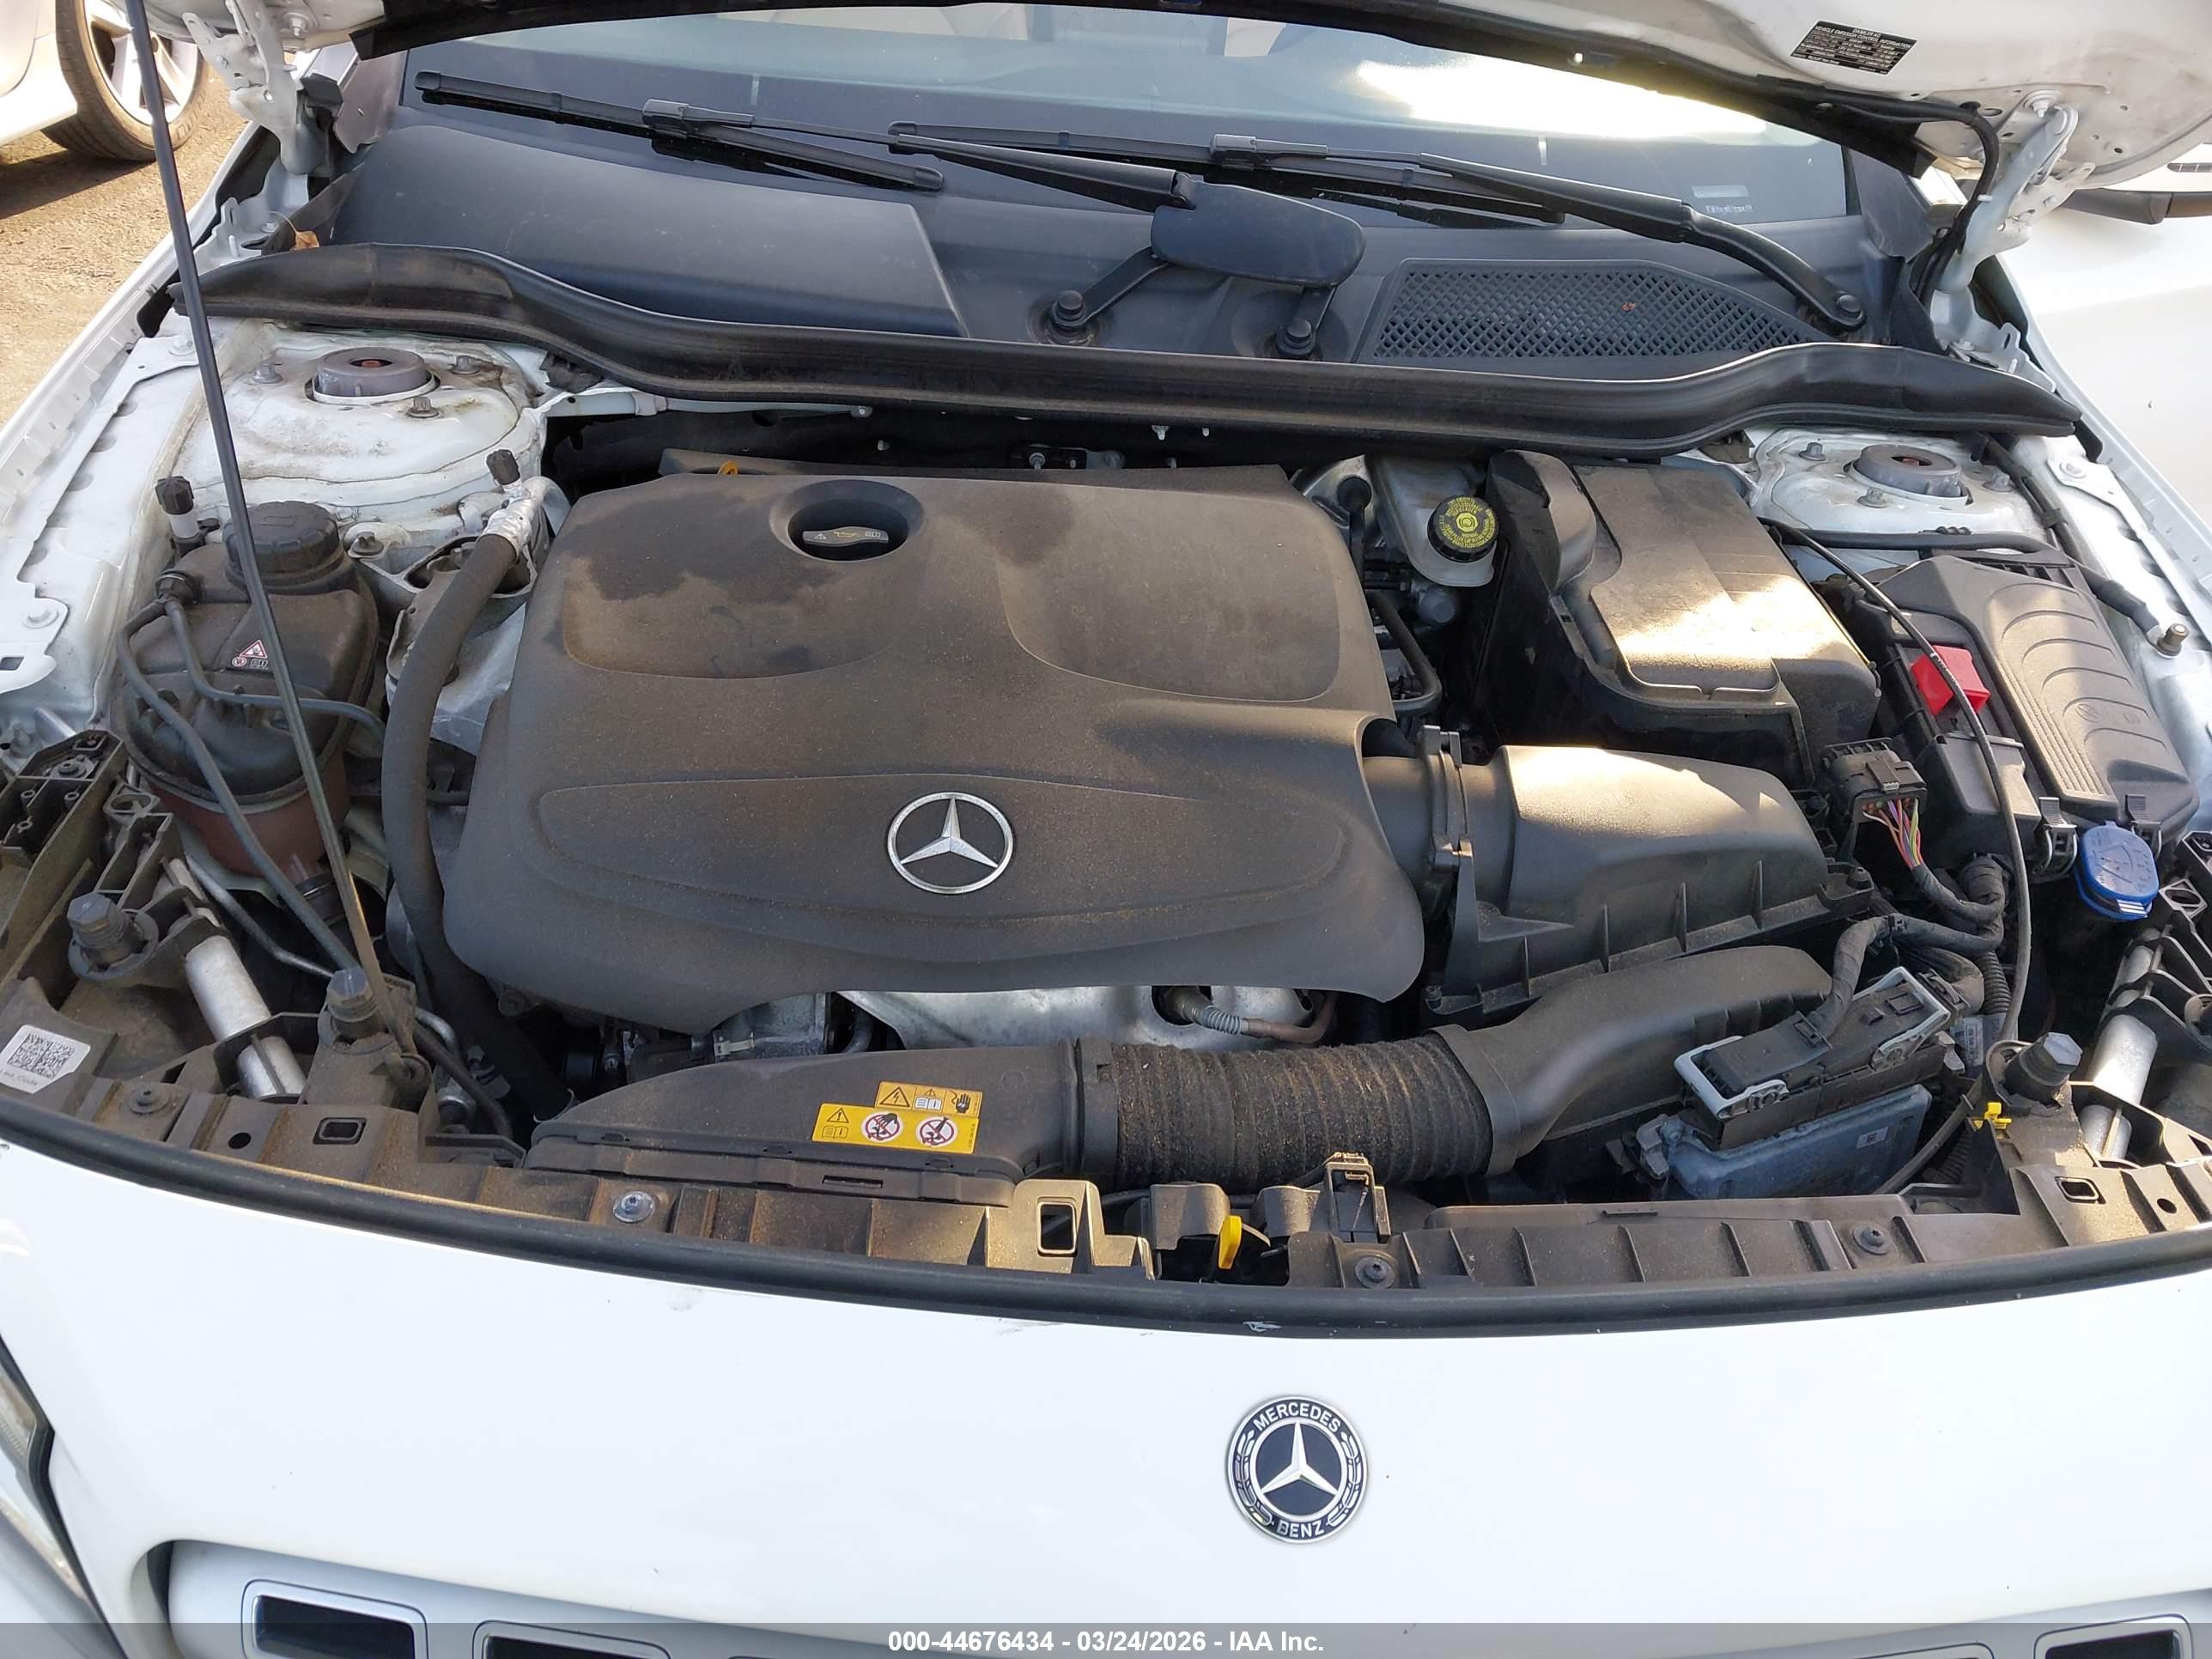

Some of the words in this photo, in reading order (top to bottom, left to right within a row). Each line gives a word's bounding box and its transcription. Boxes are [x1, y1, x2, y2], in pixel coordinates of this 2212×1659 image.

[1834, 29, 1857, 38] EMISSION
[1857, 33, 1879, 43] CONTROL
[1879, 39, 1912, 49] INFORMATION
[1253, 1402, 1341, 1433] MERCEDES
[1277, 1520, 1325, 1538] BENZ
